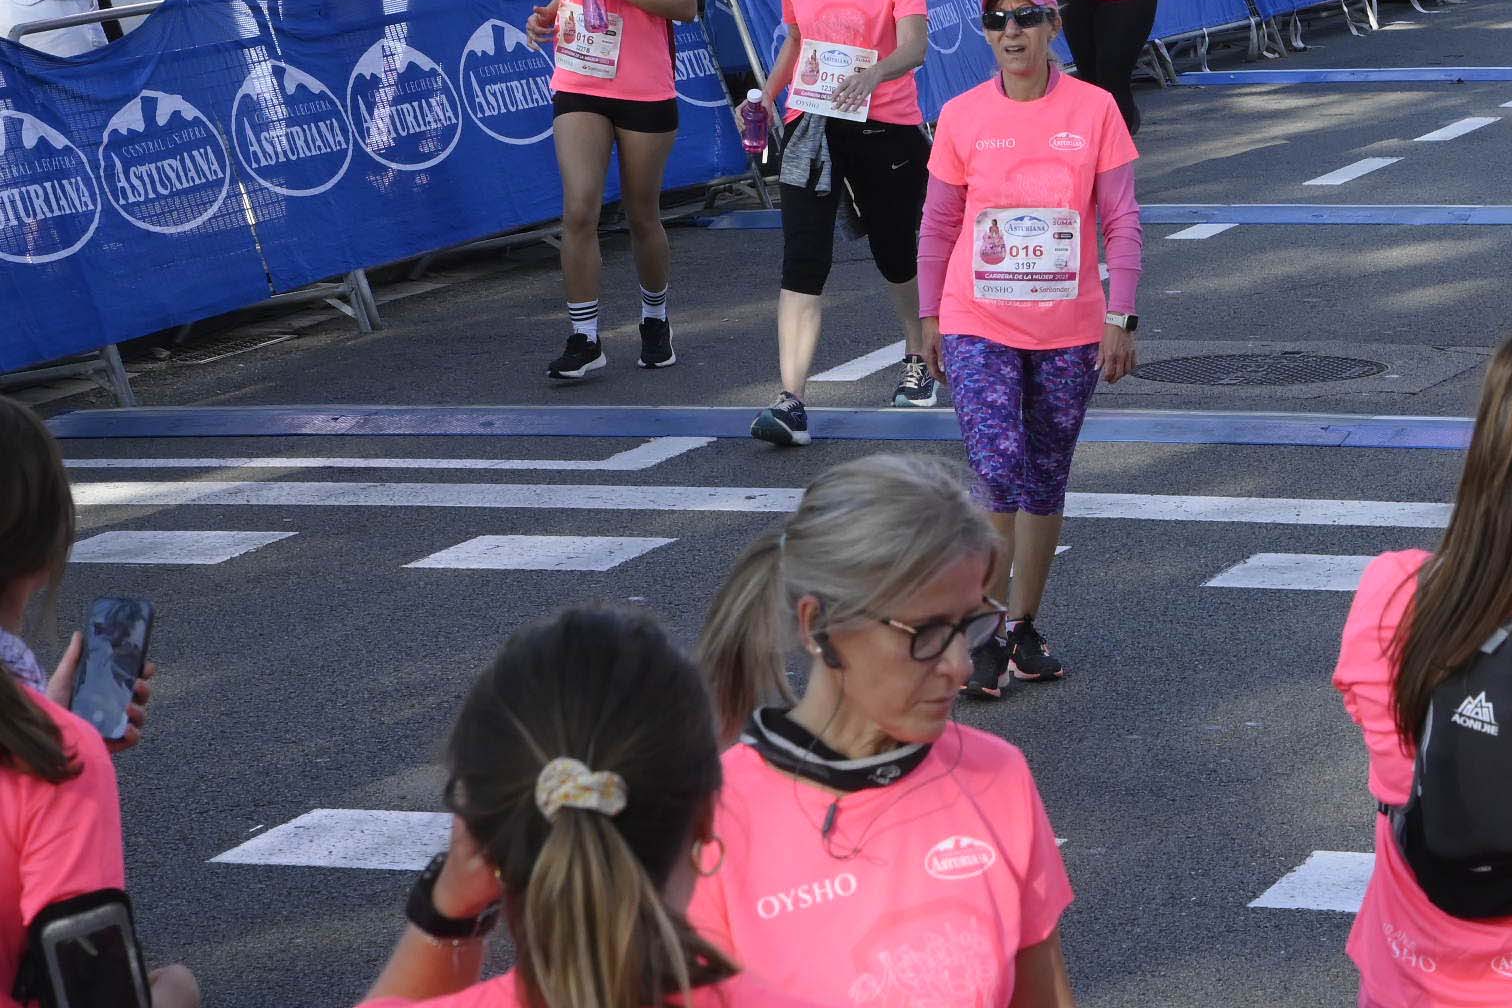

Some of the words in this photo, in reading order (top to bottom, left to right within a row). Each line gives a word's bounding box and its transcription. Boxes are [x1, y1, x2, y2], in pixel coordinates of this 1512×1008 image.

[576, 31, 595, 46] 016
[820, 71, 846, 84] 016
[469, 69, 555, 120] ASTURIAN
[358, 94, 459, 153] ASTURIANA
[243, 115, 348, 169] ASTURIANA
[976, 137, 1016, 150] OYSHO
[114, 145, 225, 207] ASTURIANA
[1009, 245, 1044, 258] 016
[1014, 261, 1037, 270] 3197
[982, 285, 1014, 294] OYSHO
[1450, 711, 1499, 737] AONIJIE
[756, 872, 858, 920] OYSHO
